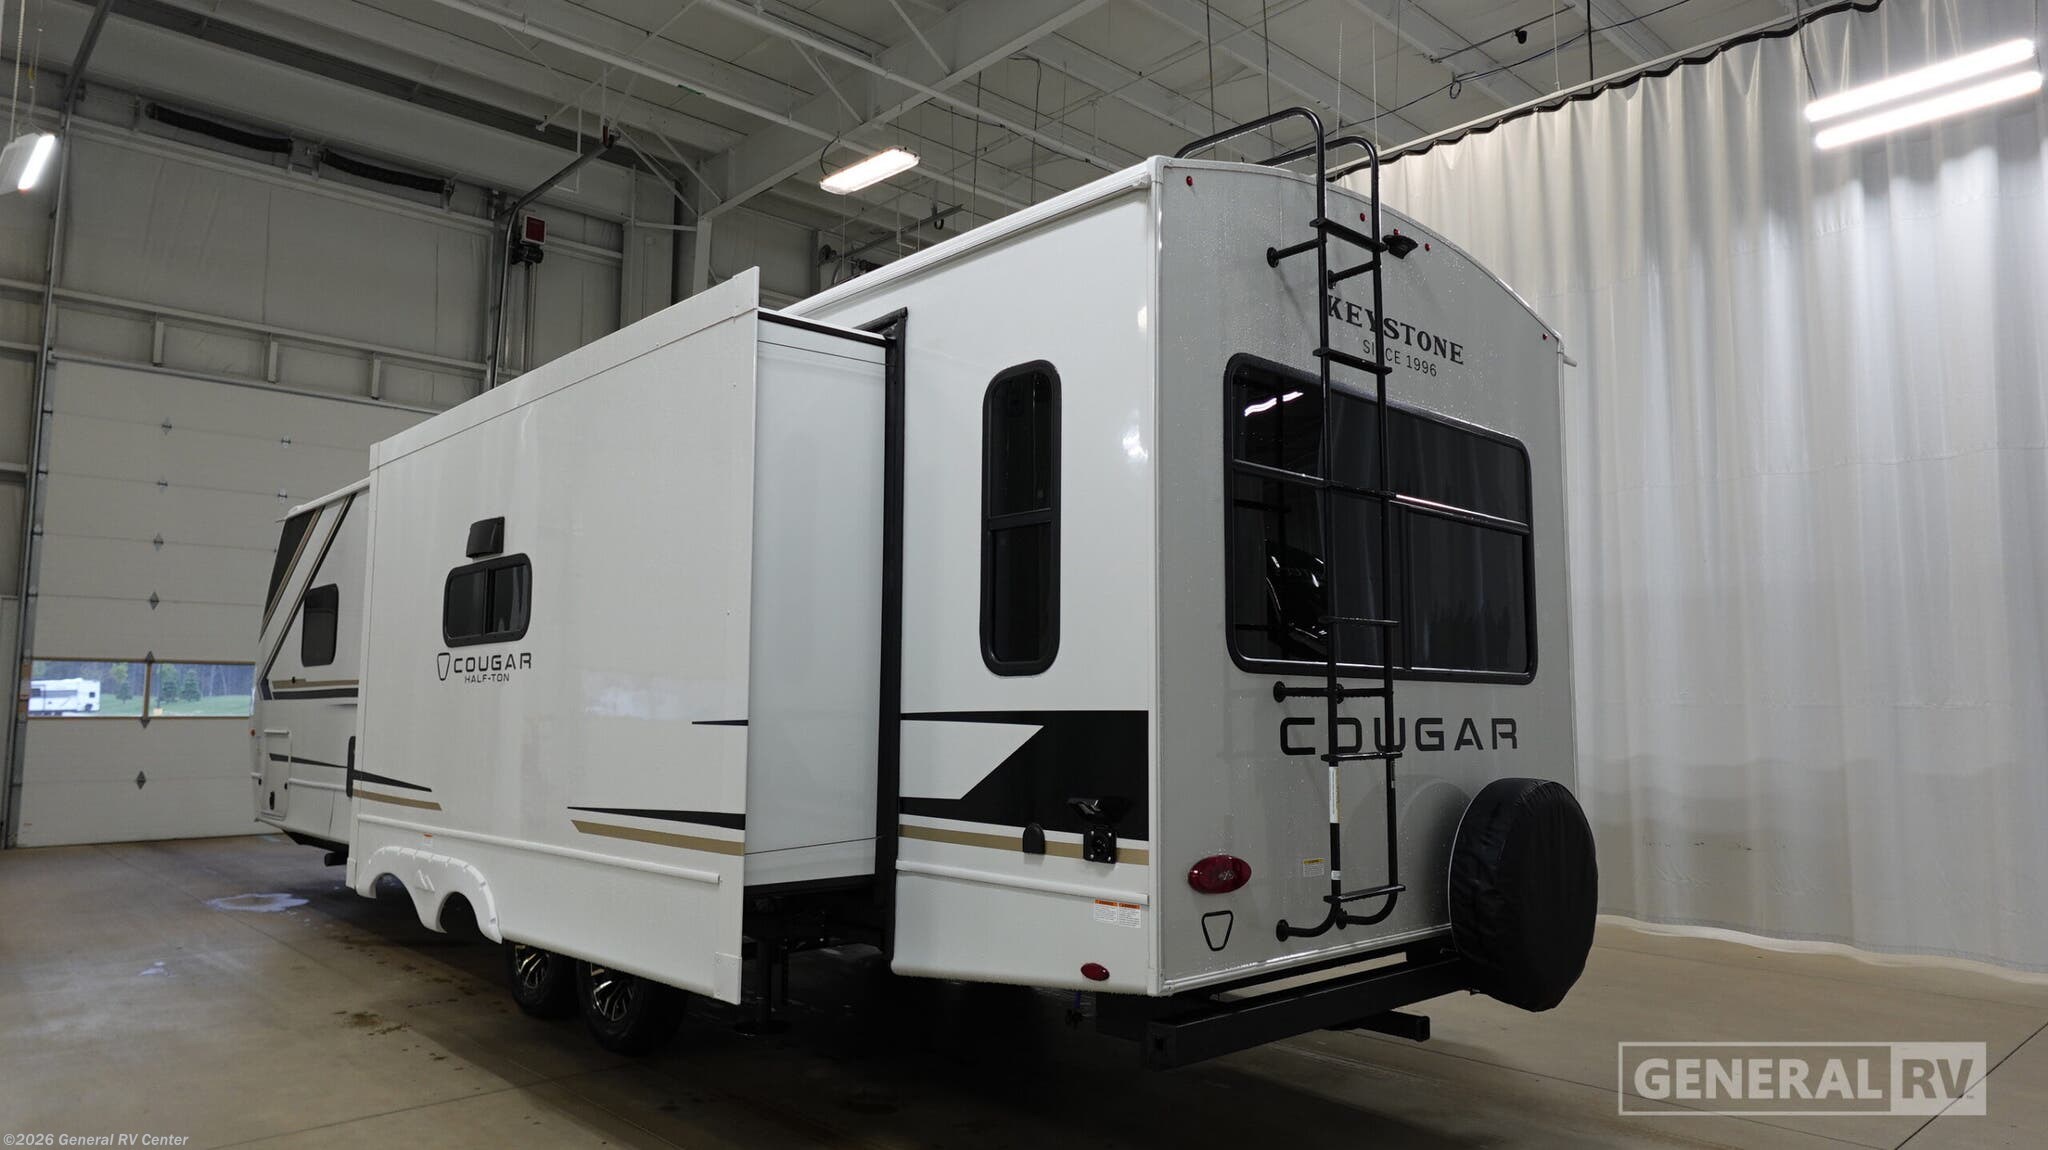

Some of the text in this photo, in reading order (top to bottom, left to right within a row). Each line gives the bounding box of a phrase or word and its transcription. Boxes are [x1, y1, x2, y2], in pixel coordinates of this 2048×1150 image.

[1363, 339, 1437, 377] SICE 1996
[454, 653, 532, 673] COUGAR
[464, 673, 510, 684] HALF-TON
[1280, 717, 1518, 756] COUGAR
